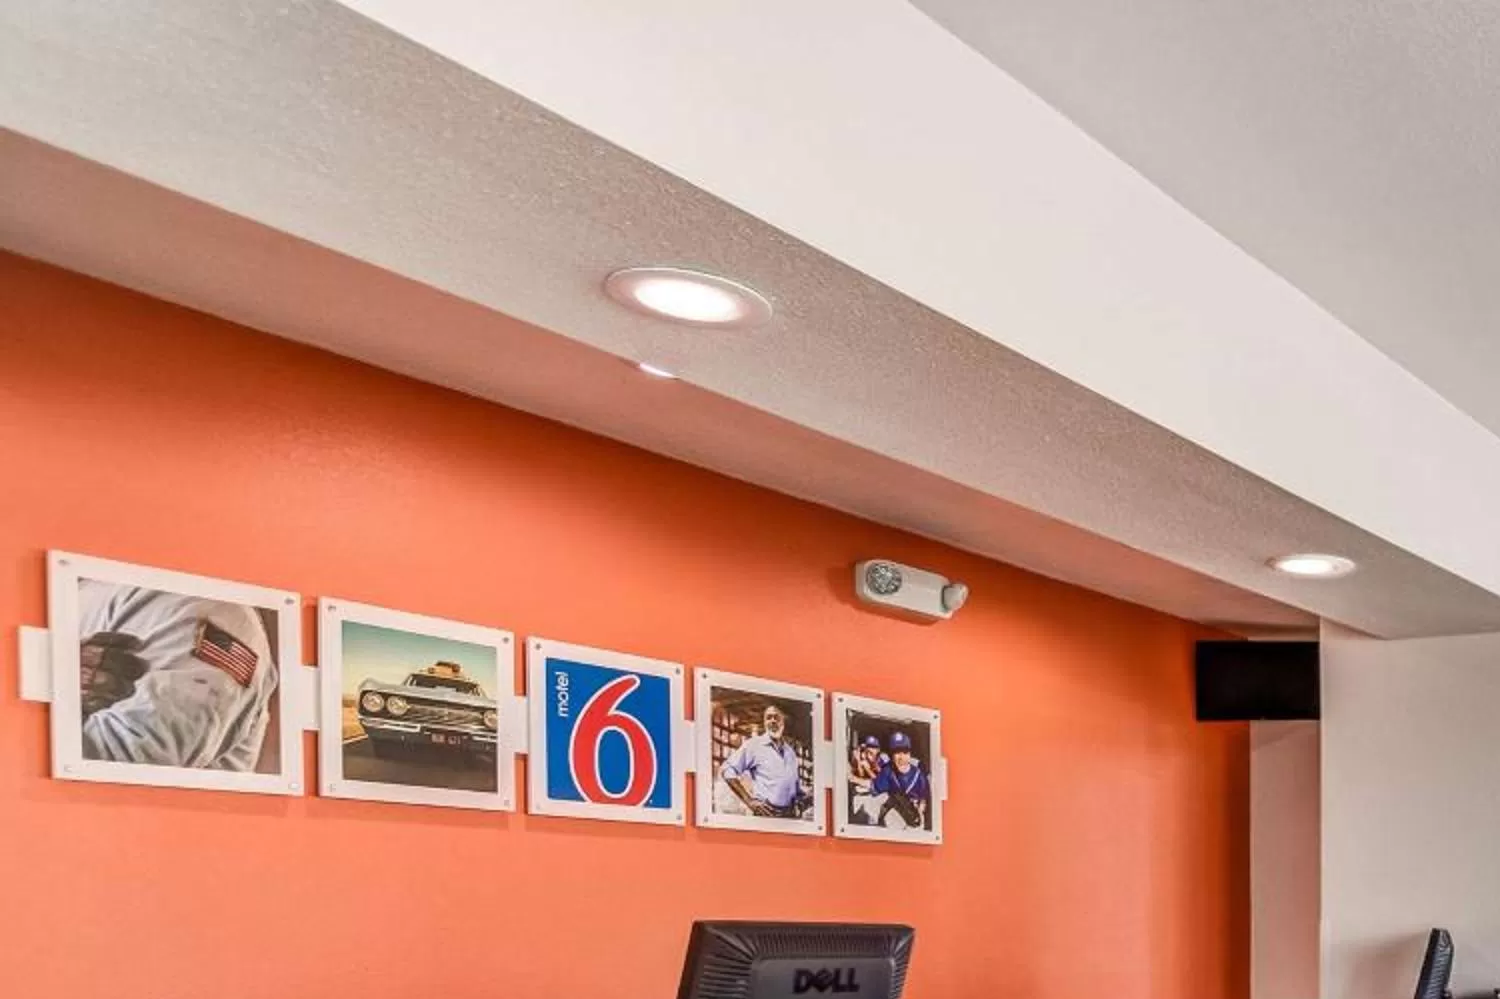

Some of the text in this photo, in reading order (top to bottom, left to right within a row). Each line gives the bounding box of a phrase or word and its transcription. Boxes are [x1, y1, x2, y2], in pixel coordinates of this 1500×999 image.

[555, 671, 658, 807] motel 6
[792, 968, 860, 994] DELL
